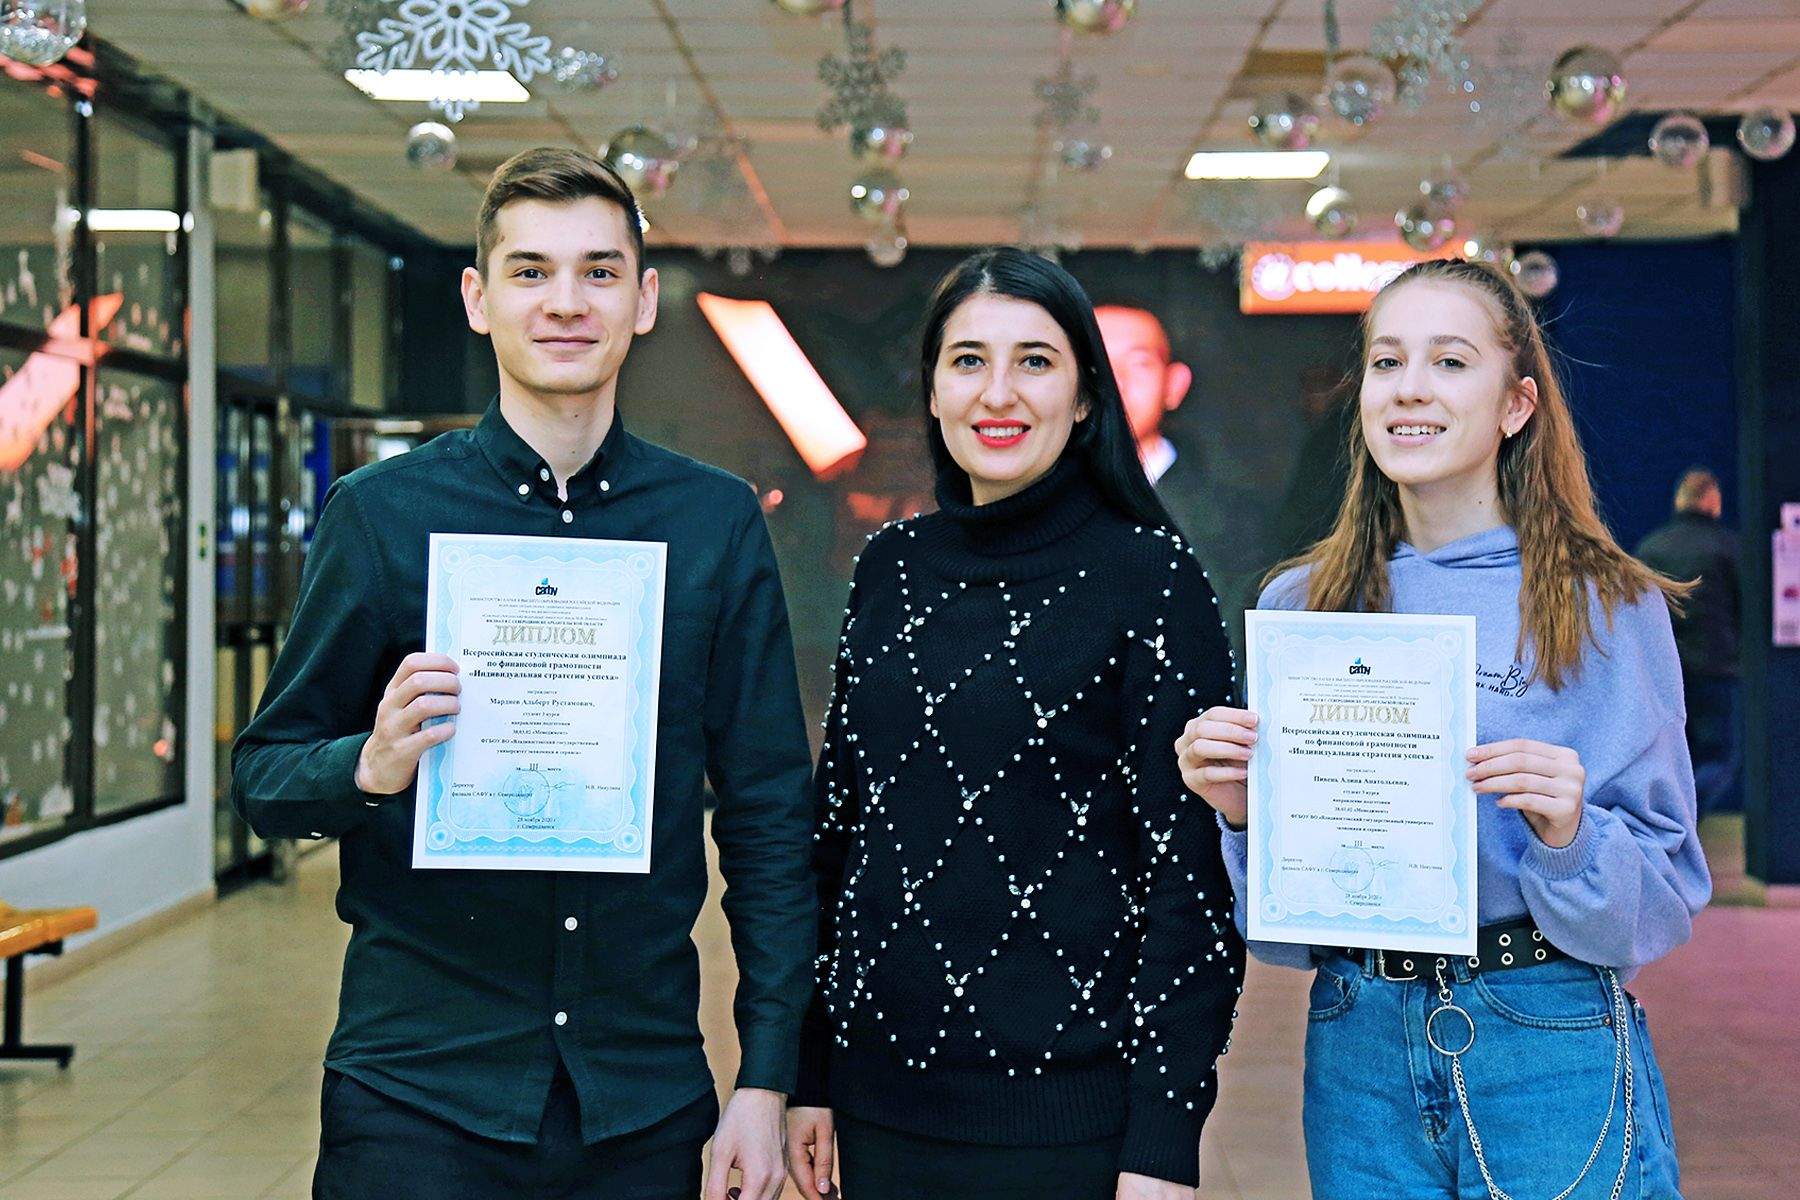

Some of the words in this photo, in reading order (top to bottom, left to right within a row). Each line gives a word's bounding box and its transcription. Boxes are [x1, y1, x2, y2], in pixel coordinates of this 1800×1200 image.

[493, 625, 597, 645] ДИПЛОМ
[463, 648, 523, 658] Всероссийская
[525, 651, 579, 659] студенческая
[499, 659, 547, 669] финансовой
[549, 662, 602, 670] грамотности
[469, 670, 541, 679] «Индивидуальная
[543, 672, 585, 680] стратегия
[587, 674, 619, 682] успеха»
[1500, 665, 1528, 697] Big
[1310, 704, 1411, 724] ДИПЛОМ
[1282, 726, 1340, 736] Всероссийская
[1341, 729, 1395, 738] студенческая
[1397, 732, 1440, 740] олимпиада
[1316, 738, 1365, 747] финансовой
[1366, 741, 1417, 749] грамотности
[1288, 747, 1360, 757] «Индивидуальная
[1362, 751, 1401, 759] стратегия
[1403, 752, 1434, 761] успеха»
